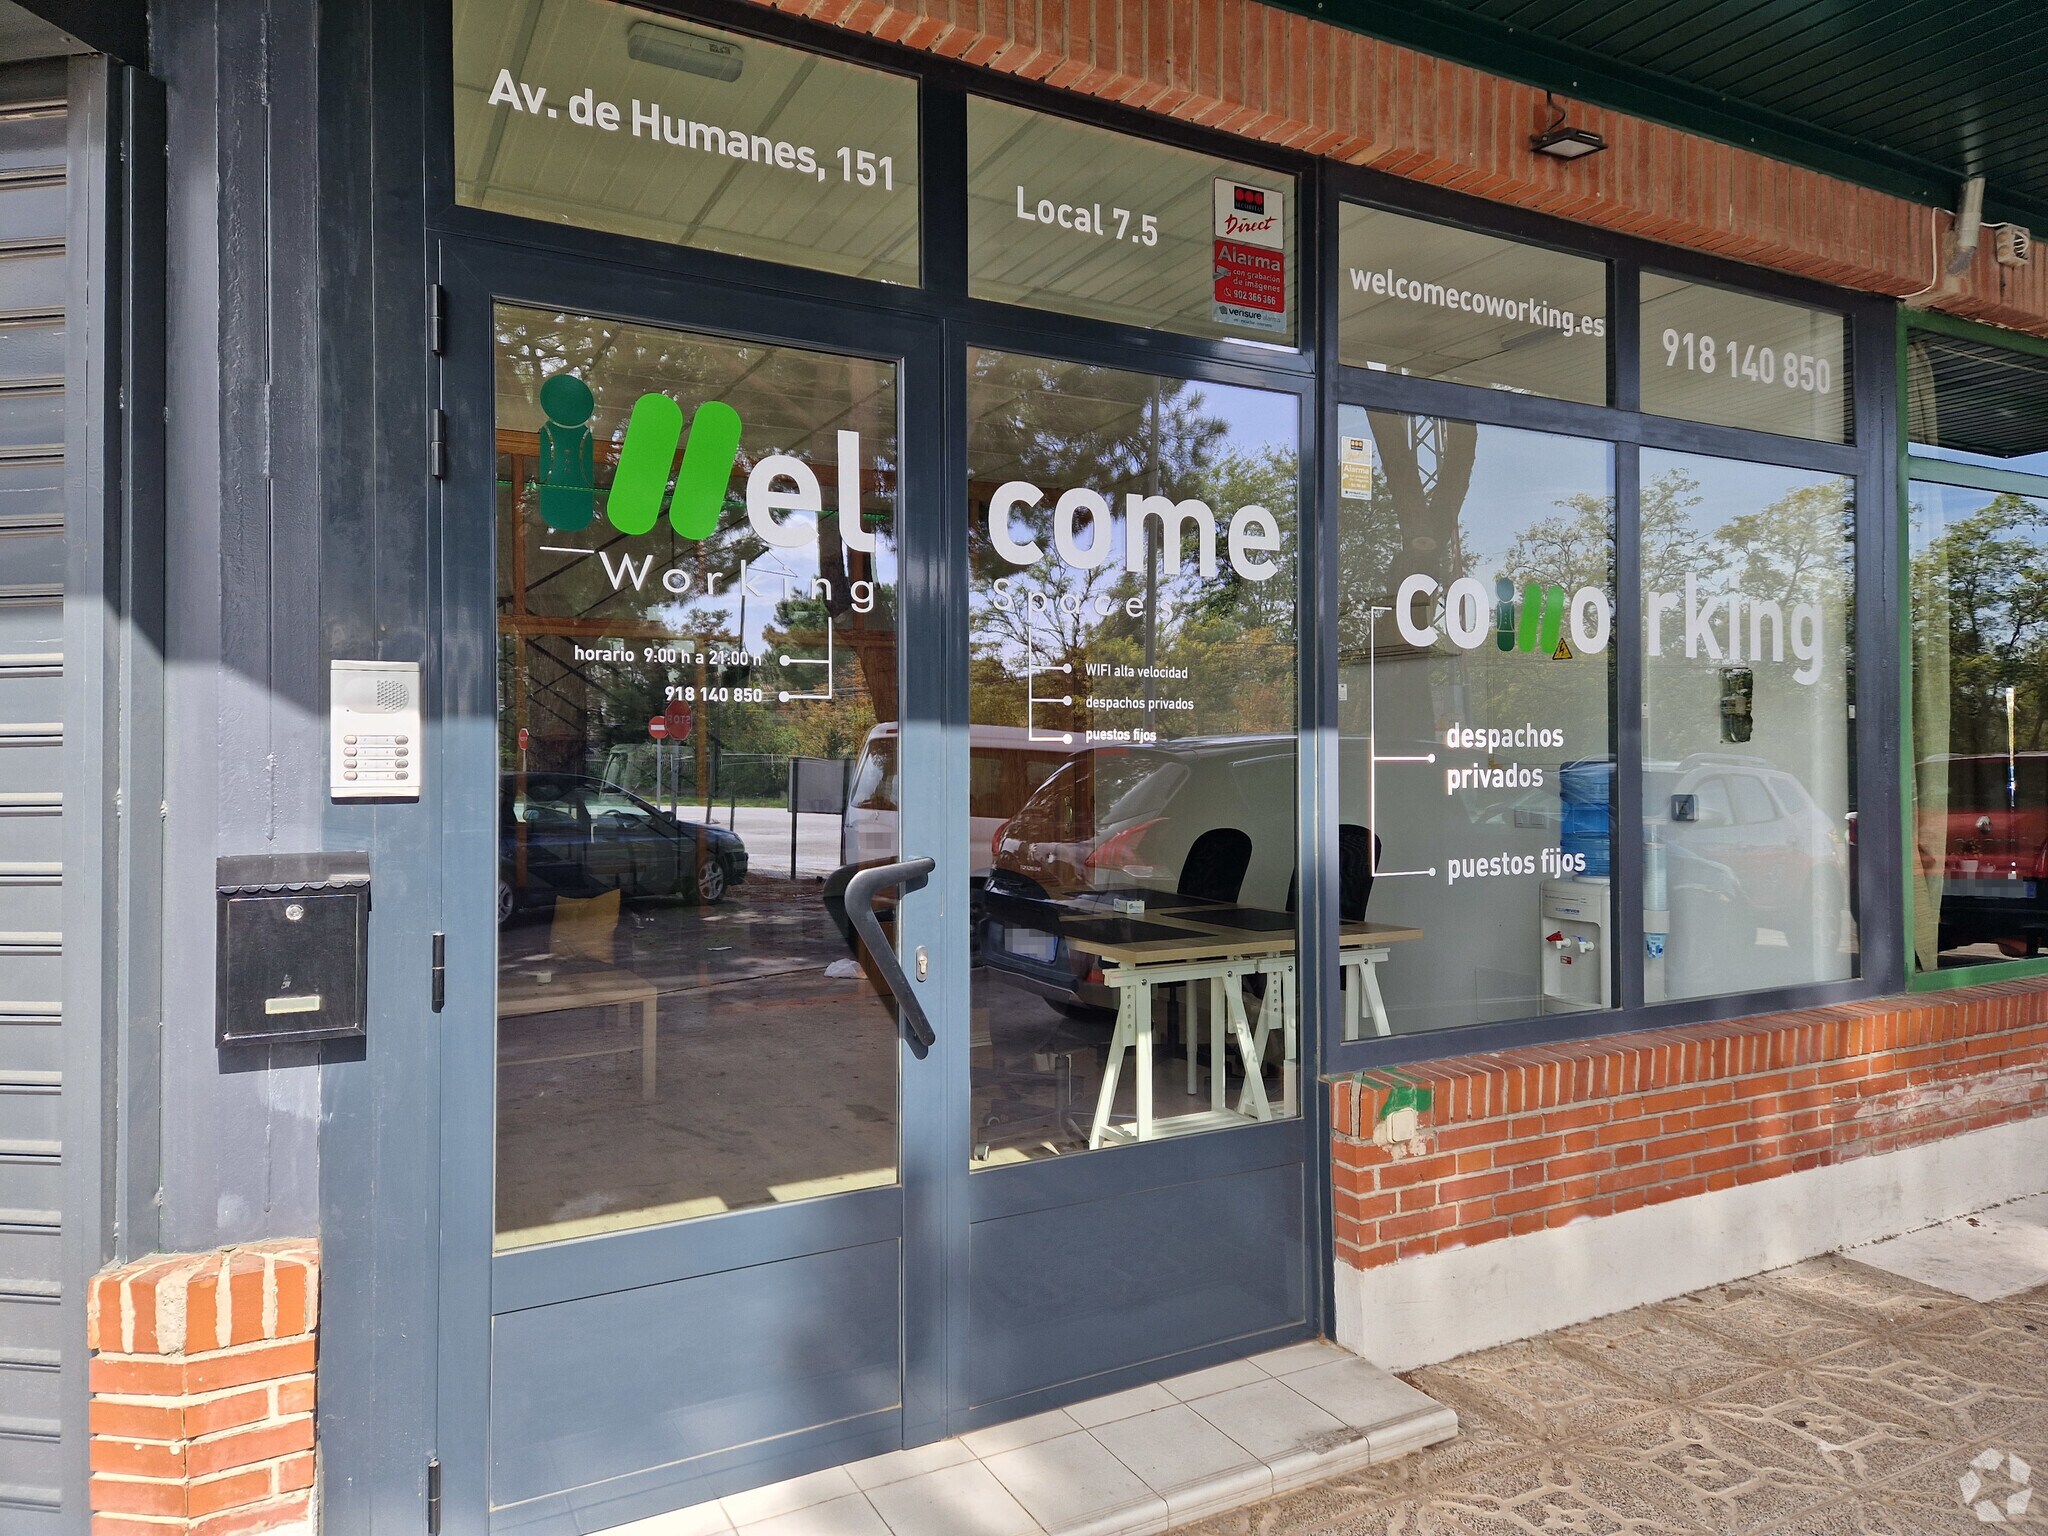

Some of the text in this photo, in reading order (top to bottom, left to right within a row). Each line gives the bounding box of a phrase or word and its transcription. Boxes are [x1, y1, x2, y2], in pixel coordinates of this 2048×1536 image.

[488, 68, 893, 191] Av. de Humanes, 151
[1016, 185, 1159, 247] Local 7.5
[1224, 213, 1278, 235] Direct
[1218, 245, 1281, 272] Alarma
[1233, 276, 1281, 293] de imágenes
[1247, 271, 1281, 283] grabación
[1233, 289, 1248, 300] 902
[1248, 291, 1263, 302] 366
[1349, 267, 1605, 338] welcomecoworking.es
[1228, 307, 1262, 320] verisure
[1662, 328, 1832, 394] 918 140 850
[599, 550, 875, 614] Working
[574, 645, 762, 666] horario 9:00 h a 21:00 h
[1086, 663, 1189, 679] WIFI alta velocidad
[664, 686, 763, 703] 918 140 850
[1086, 695, 1194, 712] despachos privados
[1085, 728, 1157, 743] puestos fijos
[1446, 722, 1564, 754] despachos
[1447, 763, 1544, 795] privados
[1448, 848, 1586, 885] puestos fijos
